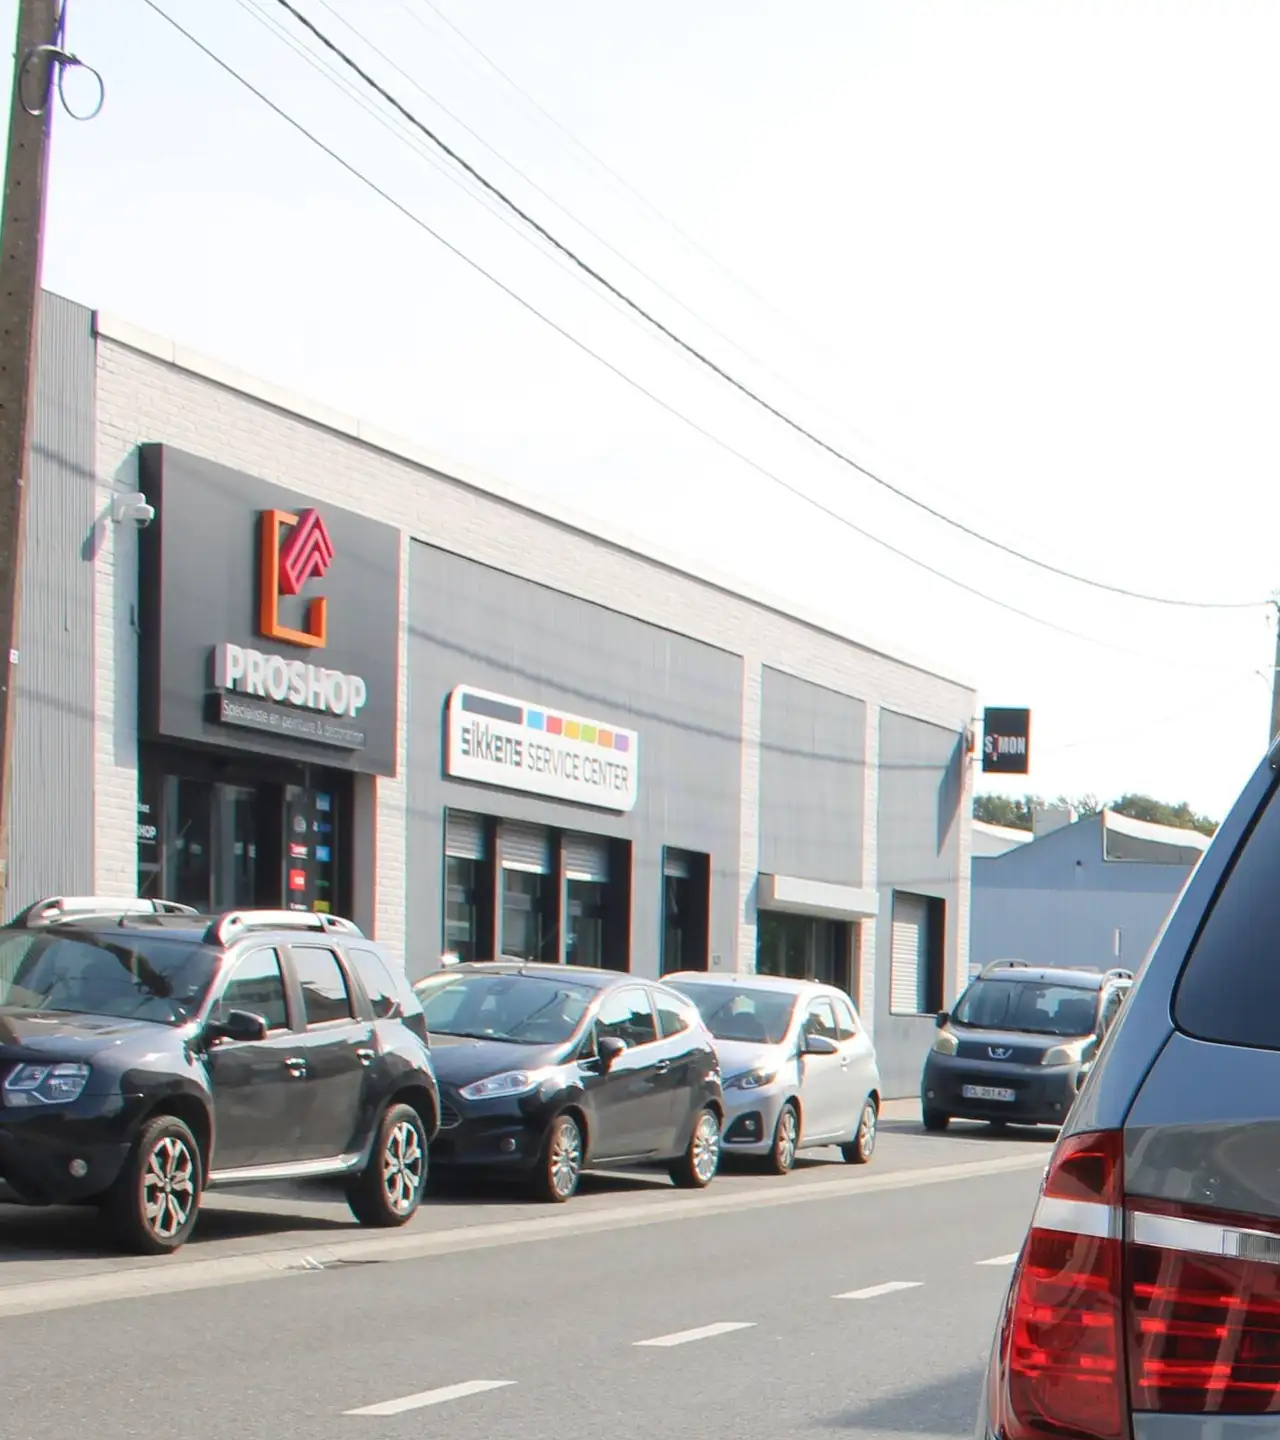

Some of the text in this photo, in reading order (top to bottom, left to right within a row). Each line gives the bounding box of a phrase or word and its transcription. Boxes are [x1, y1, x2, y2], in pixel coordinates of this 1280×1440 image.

[218, 642, 367, 718] PROSHOP
[461, 721, 629, 793] sikkens SERVICE CENTER
